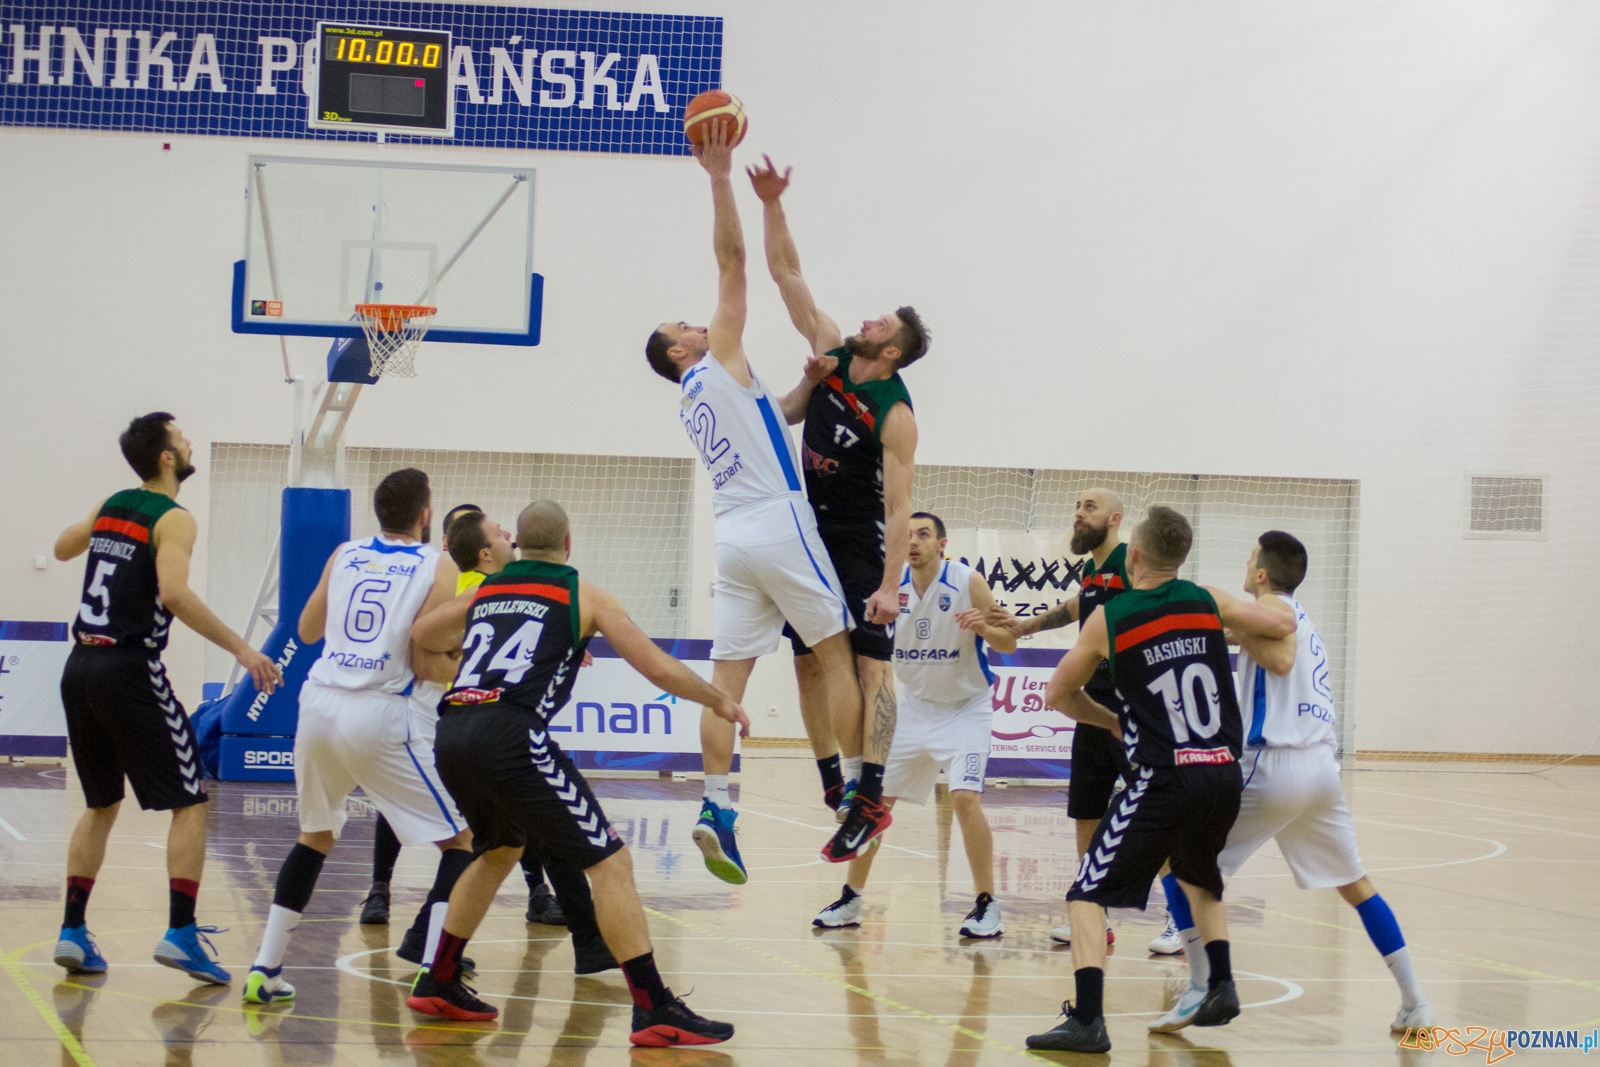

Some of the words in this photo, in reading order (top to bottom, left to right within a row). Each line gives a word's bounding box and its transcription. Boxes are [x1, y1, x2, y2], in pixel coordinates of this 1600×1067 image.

[325, 27, 383, 37] www.3d.com.pl
[0, 24, 226, 94] HNIKA
[336, 38, 441, 67] 10.00.0
[323, 111, 339, 121] 3D
[833, 423, 860, 448] 17
[80, 559, 117, 626] 5
[344, 579, 391, 643] 6
[472, 600, 550, 620] KOWALEWSKI
[914, 617, 931, 640] 8
[453, 620, 545, 690] 24
[895, 648, 961, 660] BIOFARM
[1142, 636, 1208, 666] BASIŃSKI
[1146, 662, 1222, 744] 10
[965, 753, 980, 775] 8
